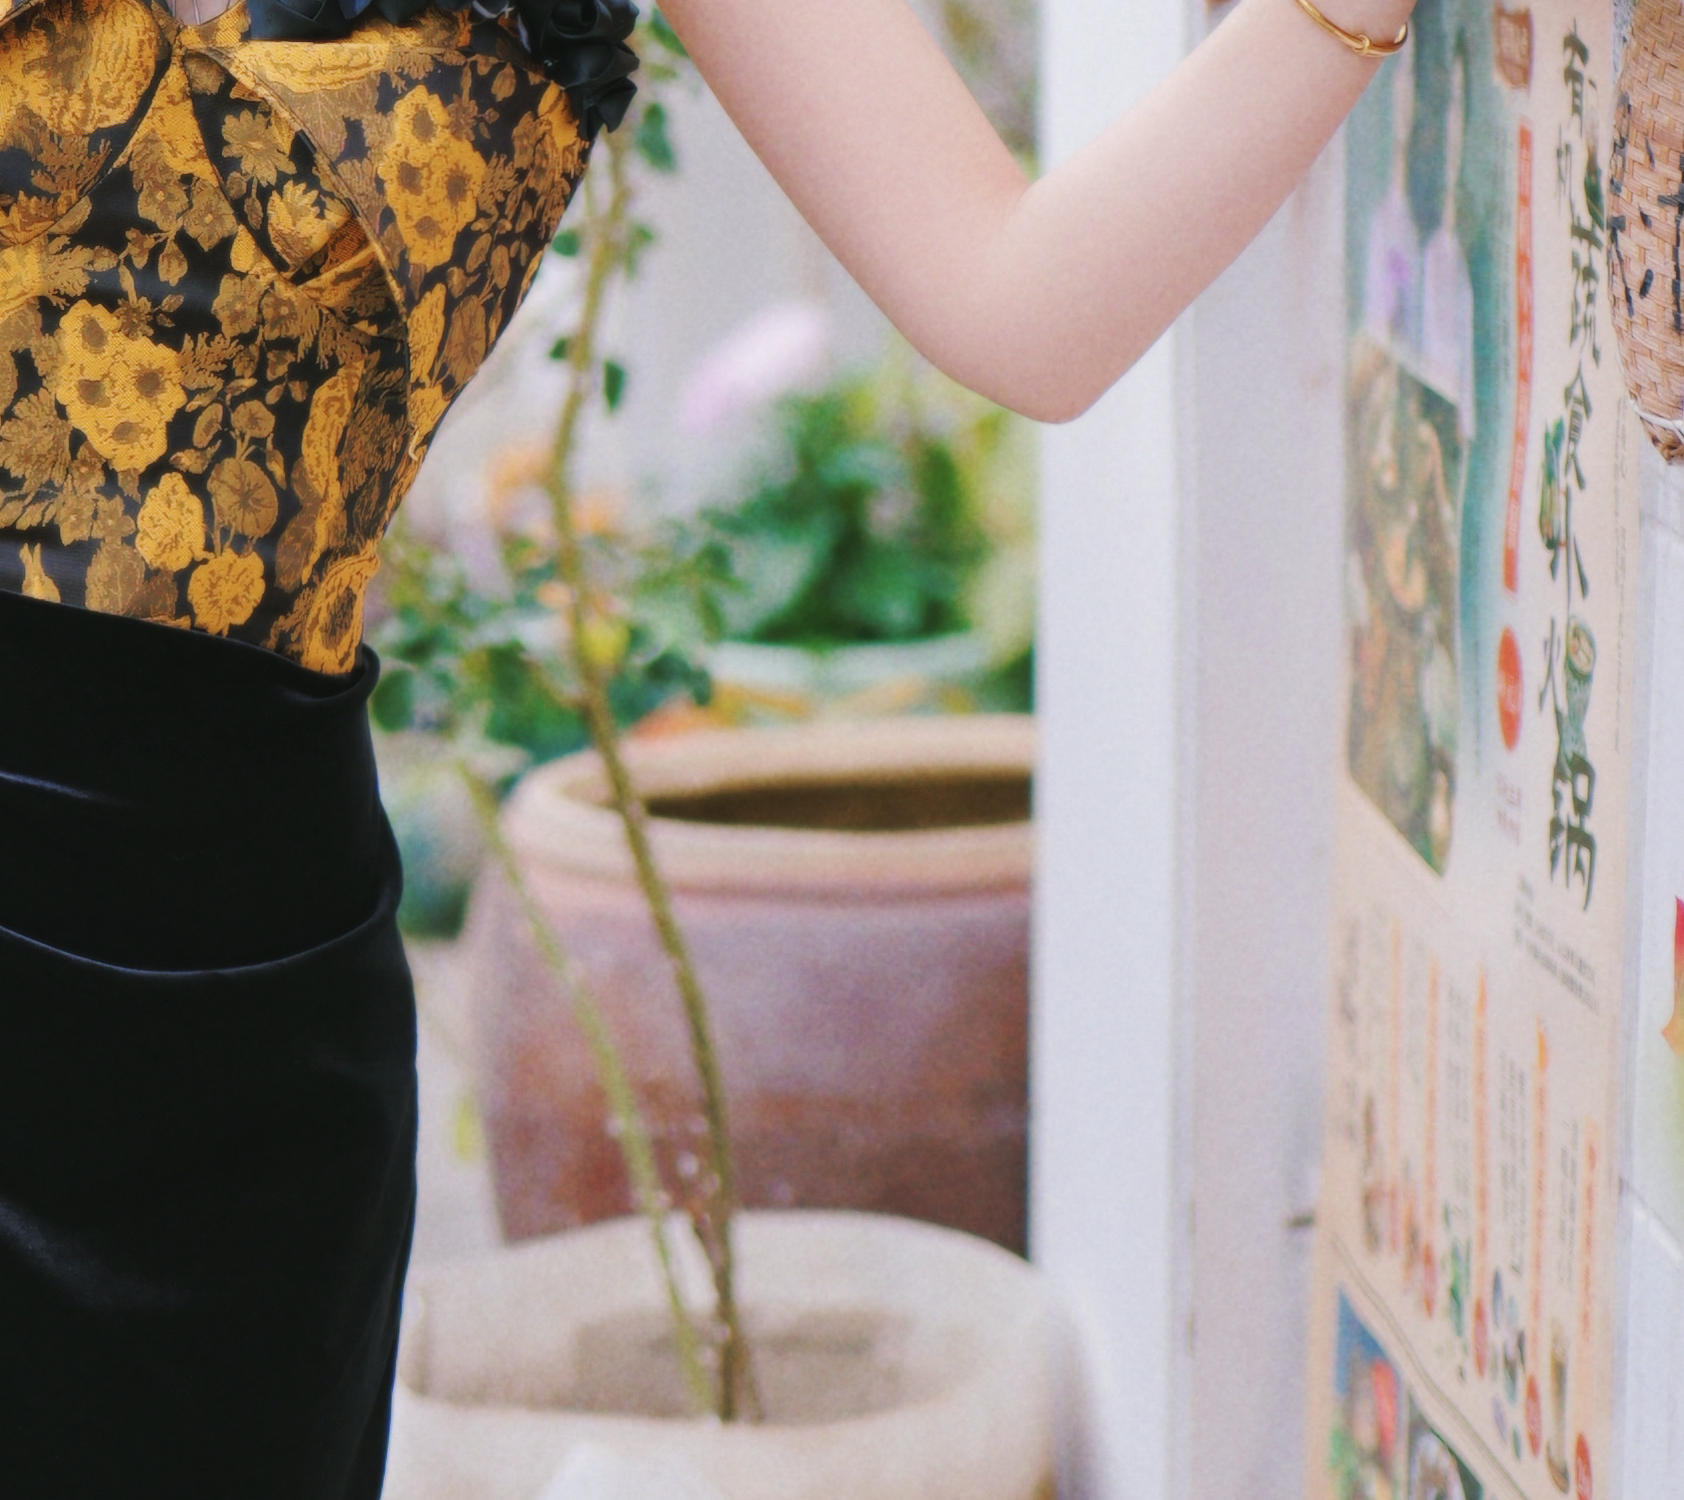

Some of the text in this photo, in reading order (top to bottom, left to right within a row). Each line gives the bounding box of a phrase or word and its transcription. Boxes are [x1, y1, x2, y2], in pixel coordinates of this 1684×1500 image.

[1538, 18, 1603, 911] 有机蔬食小火锅
